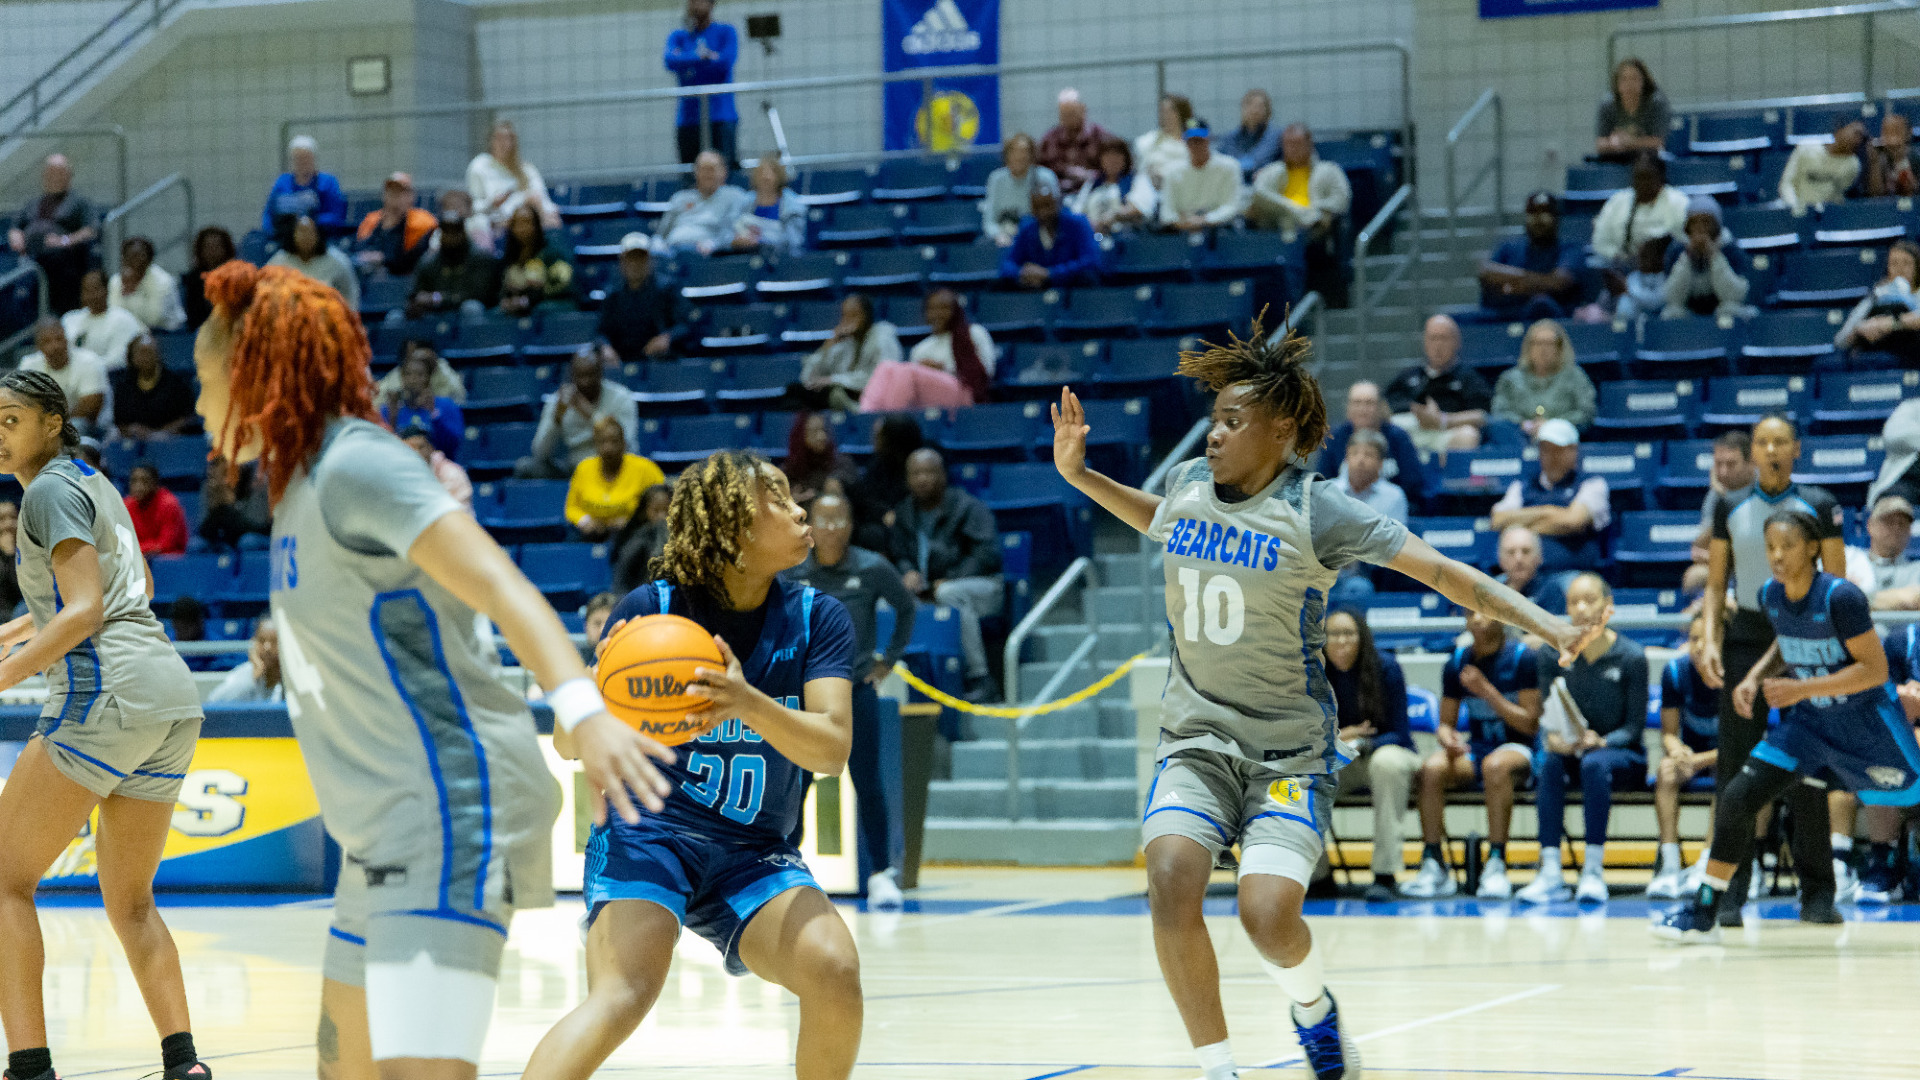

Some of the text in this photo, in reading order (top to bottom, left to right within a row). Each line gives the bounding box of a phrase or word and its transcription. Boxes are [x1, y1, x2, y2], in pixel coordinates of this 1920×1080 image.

[1167, 518, 1281, 572] BEARCATS
[1178, 566, 1245, 646] 10
[625, 674, 712, 699] Wils
[680, 751, 766, 826] 30
